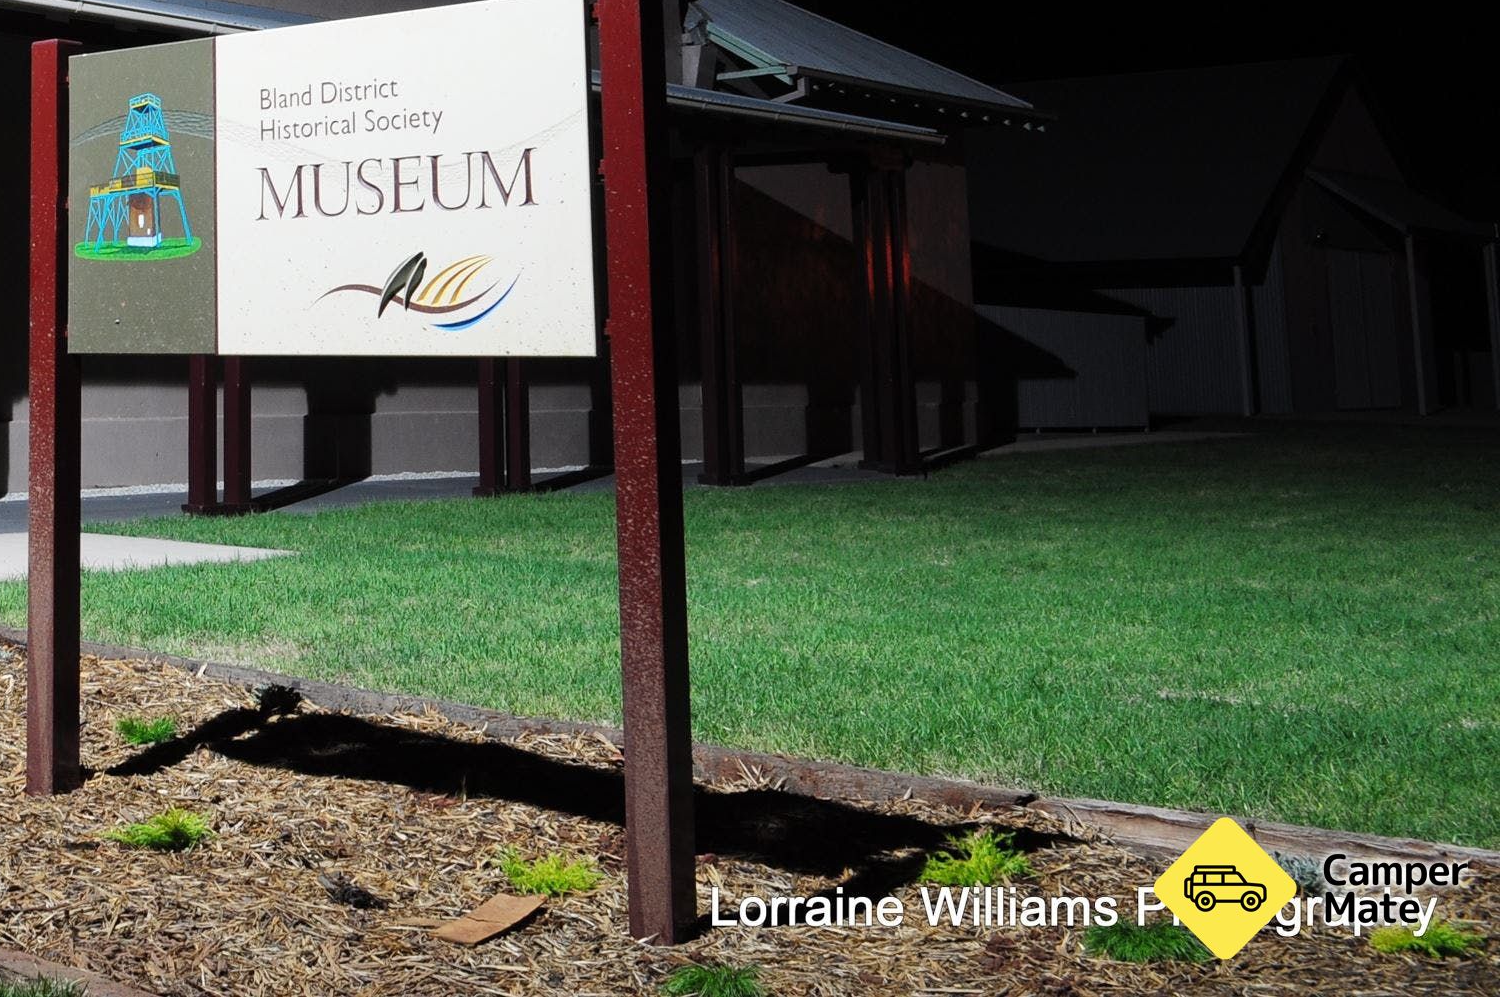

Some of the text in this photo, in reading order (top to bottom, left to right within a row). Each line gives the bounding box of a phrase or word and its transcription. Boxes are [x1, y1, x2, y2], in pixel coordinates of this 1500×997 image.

[259, 78, 399, 110] Bland District
[260, 108, 443, 141] Historical Society
[255, 147, 539, 221] MUSEUM
